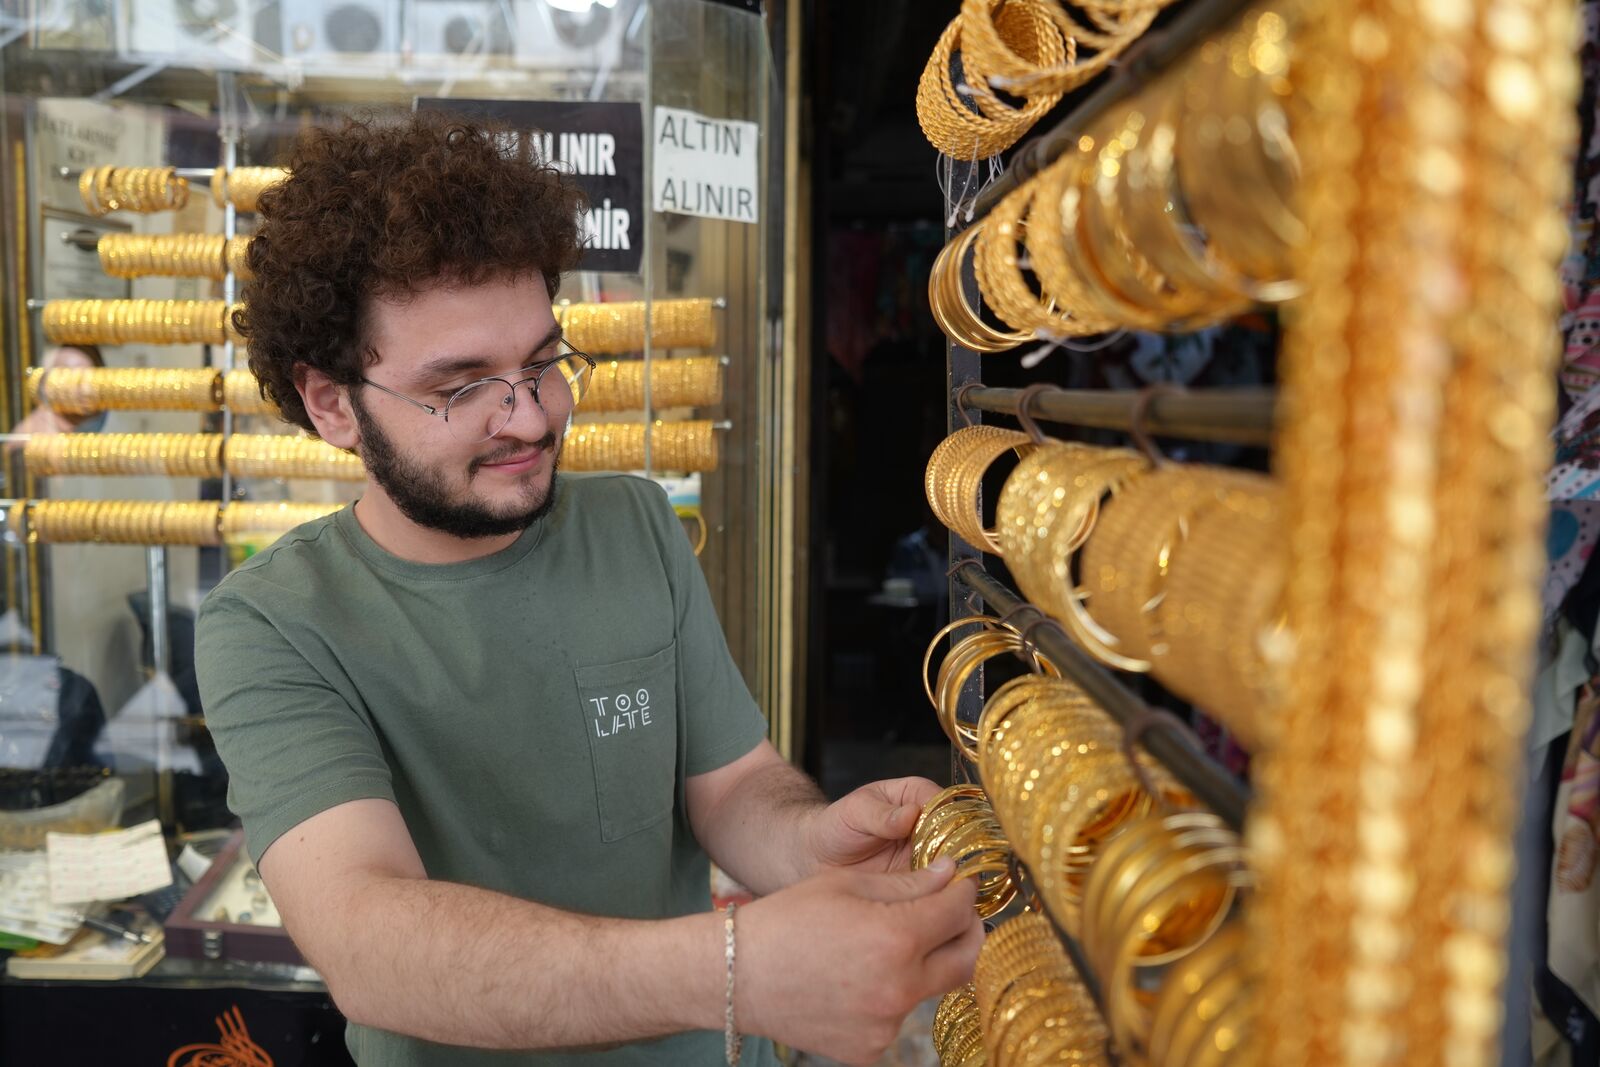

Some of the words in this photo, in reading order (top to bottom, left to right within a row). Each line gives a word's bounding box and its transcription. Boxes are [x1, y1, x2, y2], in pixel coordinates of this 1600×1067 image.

[660, 115, 742, 157] ALTIN
[660, 178, 753, 218] ALINIR
[589, 688, 649, 716] TOO
[595, 706, 652, 737] LATE
